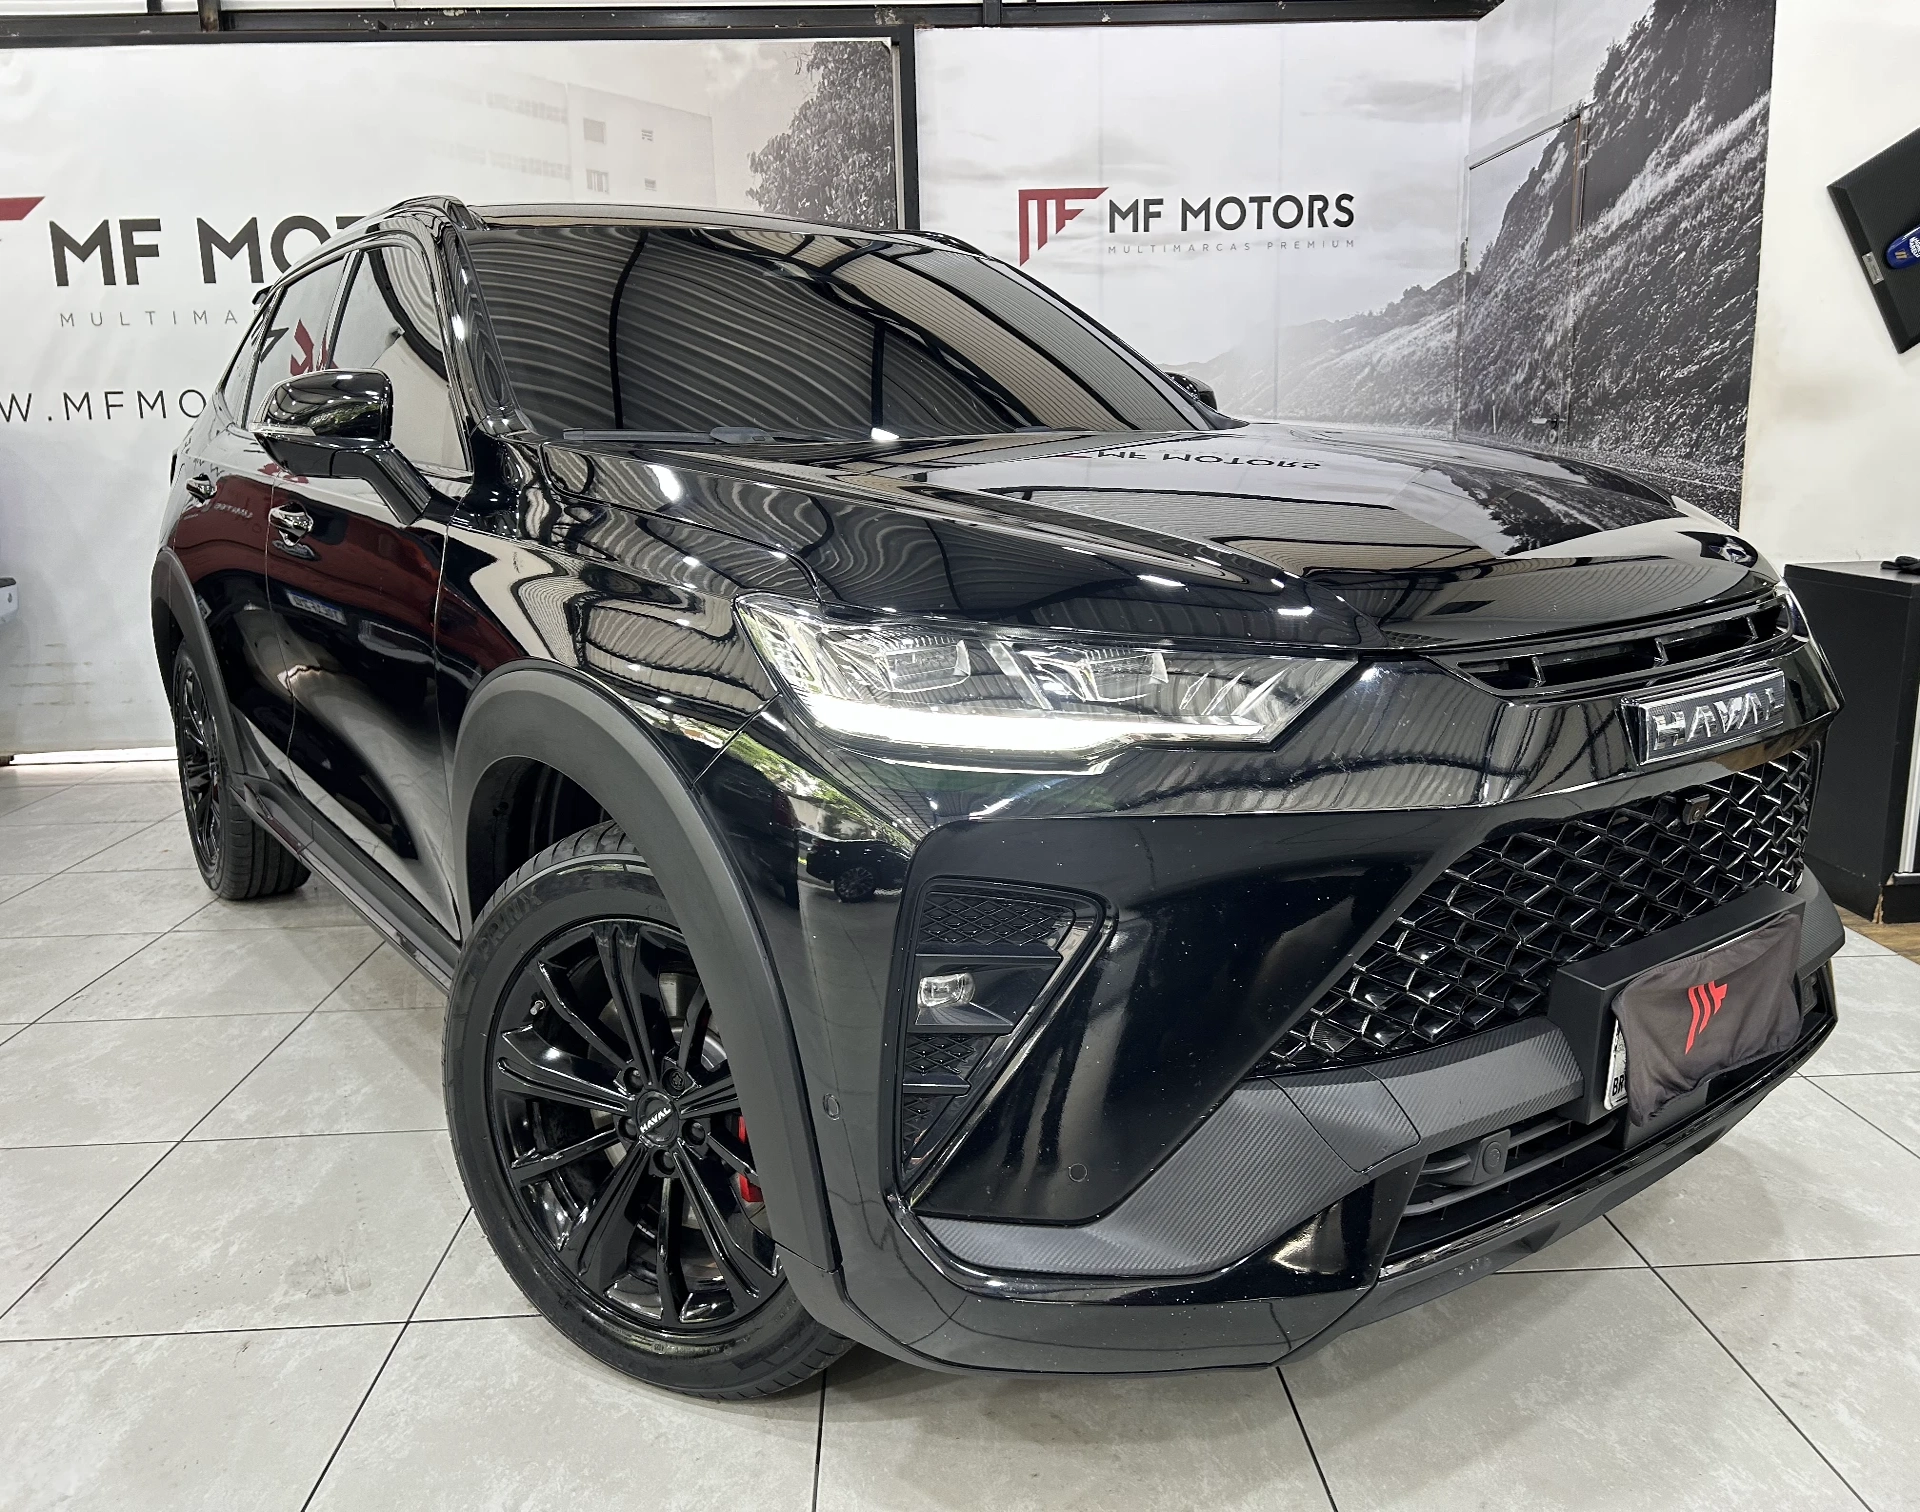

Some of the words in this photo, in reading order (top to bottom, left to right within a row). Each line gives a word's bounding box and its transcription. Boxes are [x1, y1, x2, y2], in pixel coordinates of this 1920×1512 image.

[1109, 198, 1164, 233] MF
[1181, 193, 1354, 232] MOTORS
[49, 218, 161, 287] MF
[1108, 243, 1251, 254] MULTIMARCAS
[1267, 240, 1354, 250] PREMIUM
[1652, 687, 1784, 750] HAVAL
[640, 1107, 671, 1133] HAVAL
